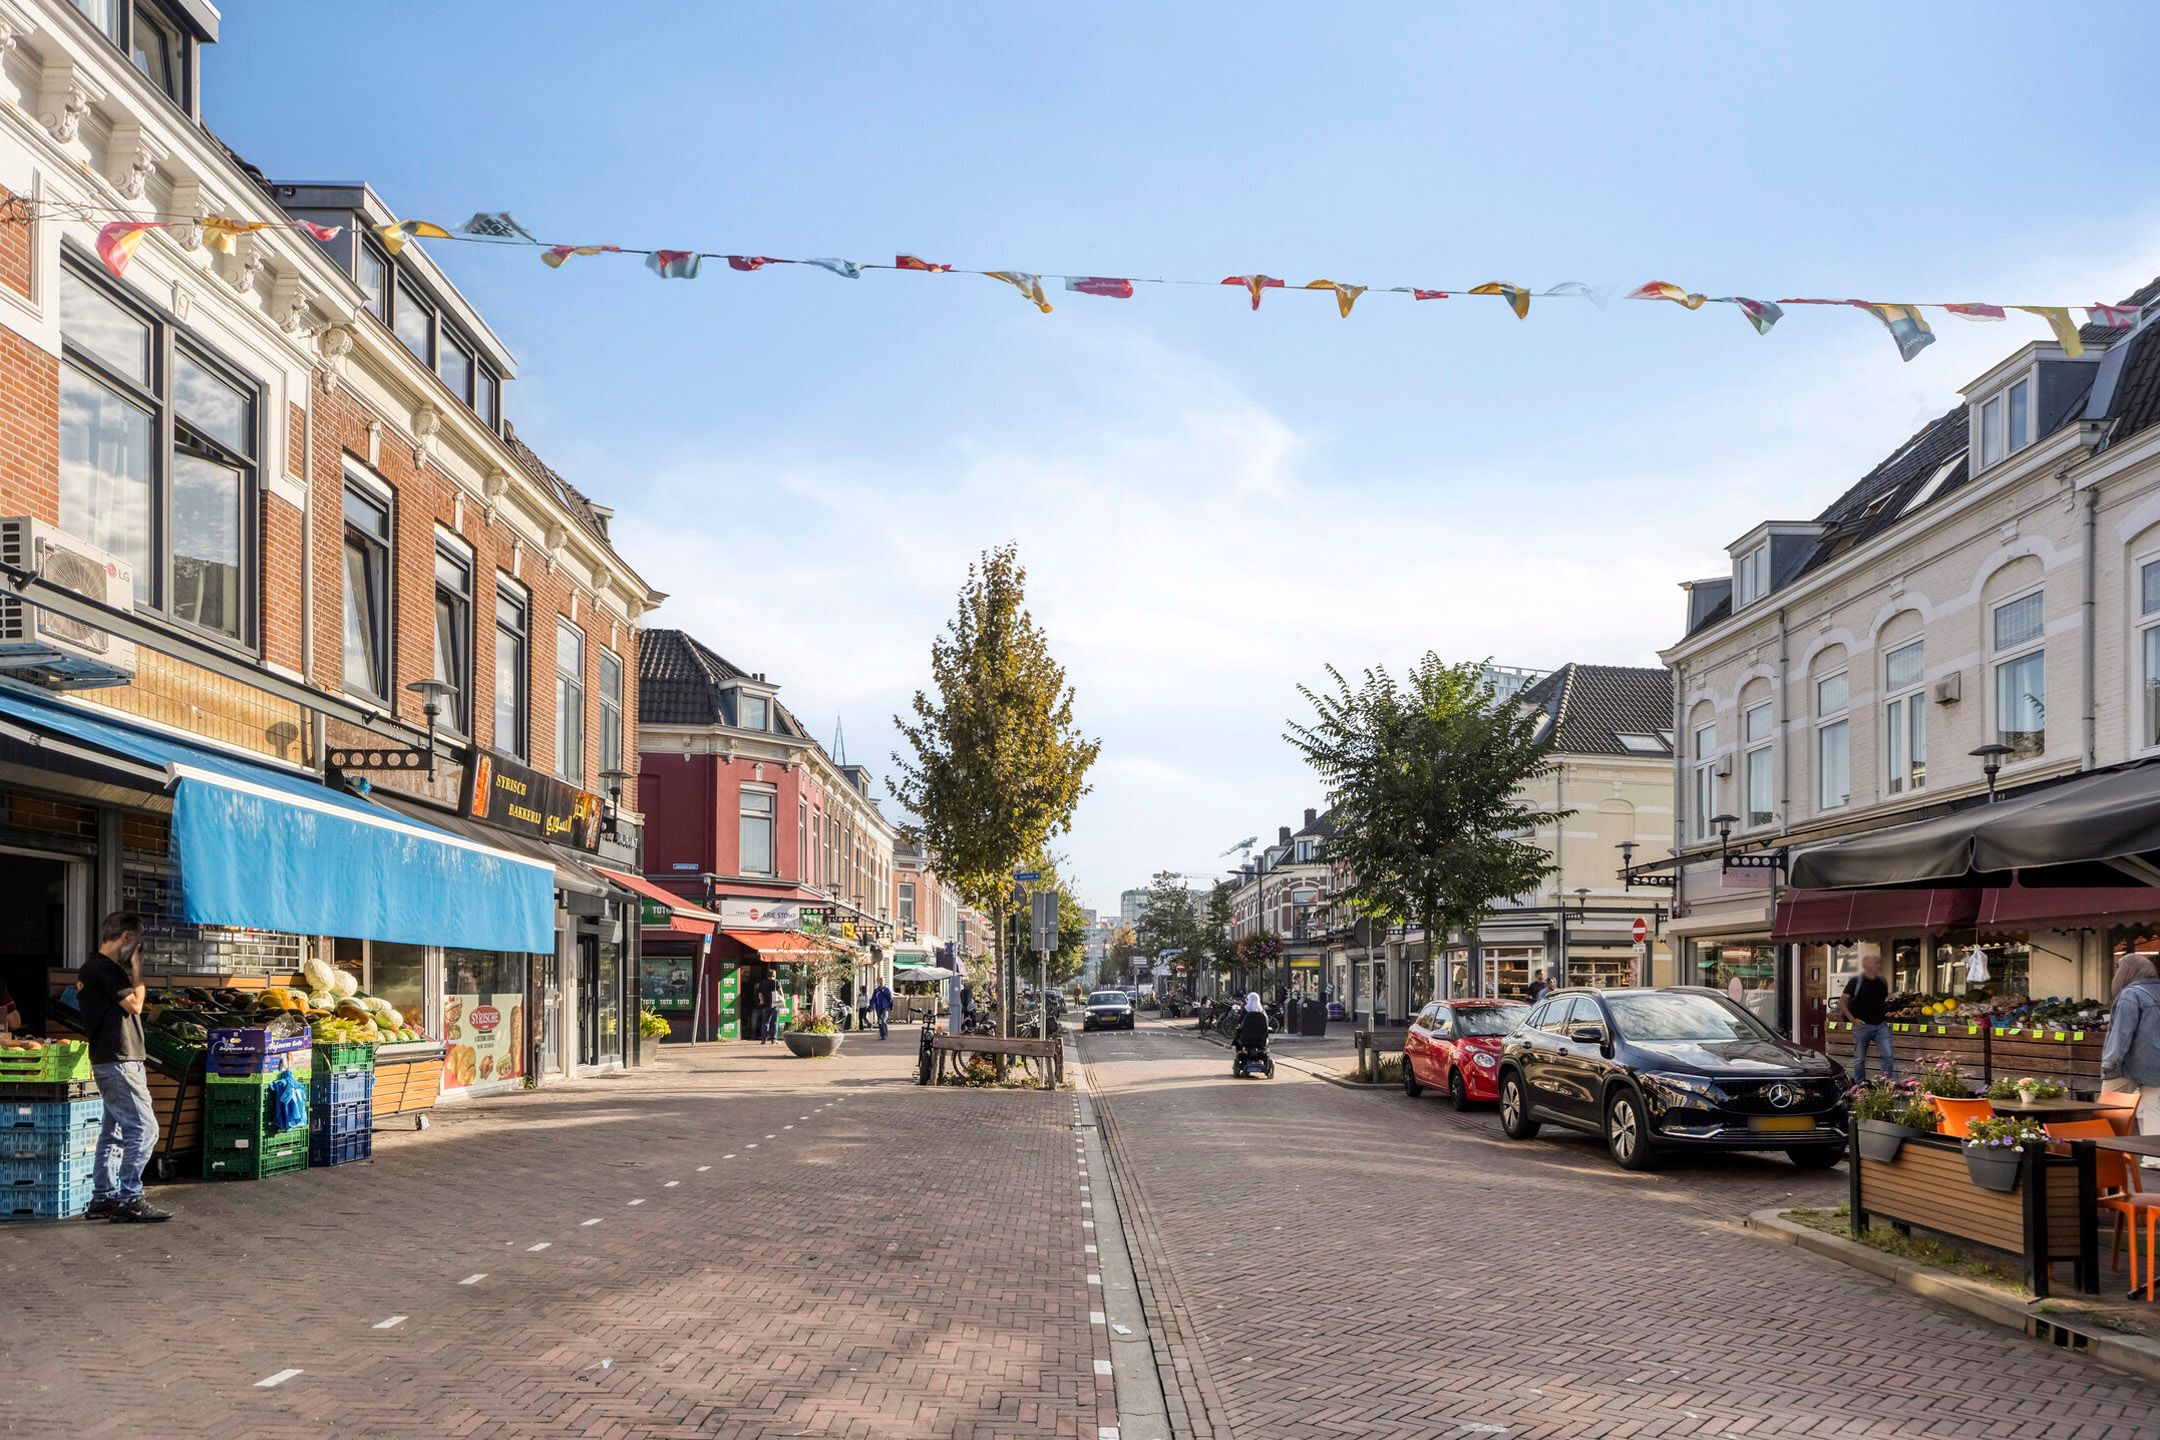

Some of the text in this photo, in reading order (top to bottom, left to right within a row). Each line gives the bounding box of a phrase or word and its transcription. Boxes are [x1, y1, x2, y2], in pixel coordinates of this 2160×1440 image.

[118, 569, 130, 582] LG
[495, 774, 527, 796] SYRISCH
[508, 803, 542, 825] BAKKERIJ
[762, 911, 776, 919] ARIE
[471, 1011, 499, 1025] SYRISCHE
